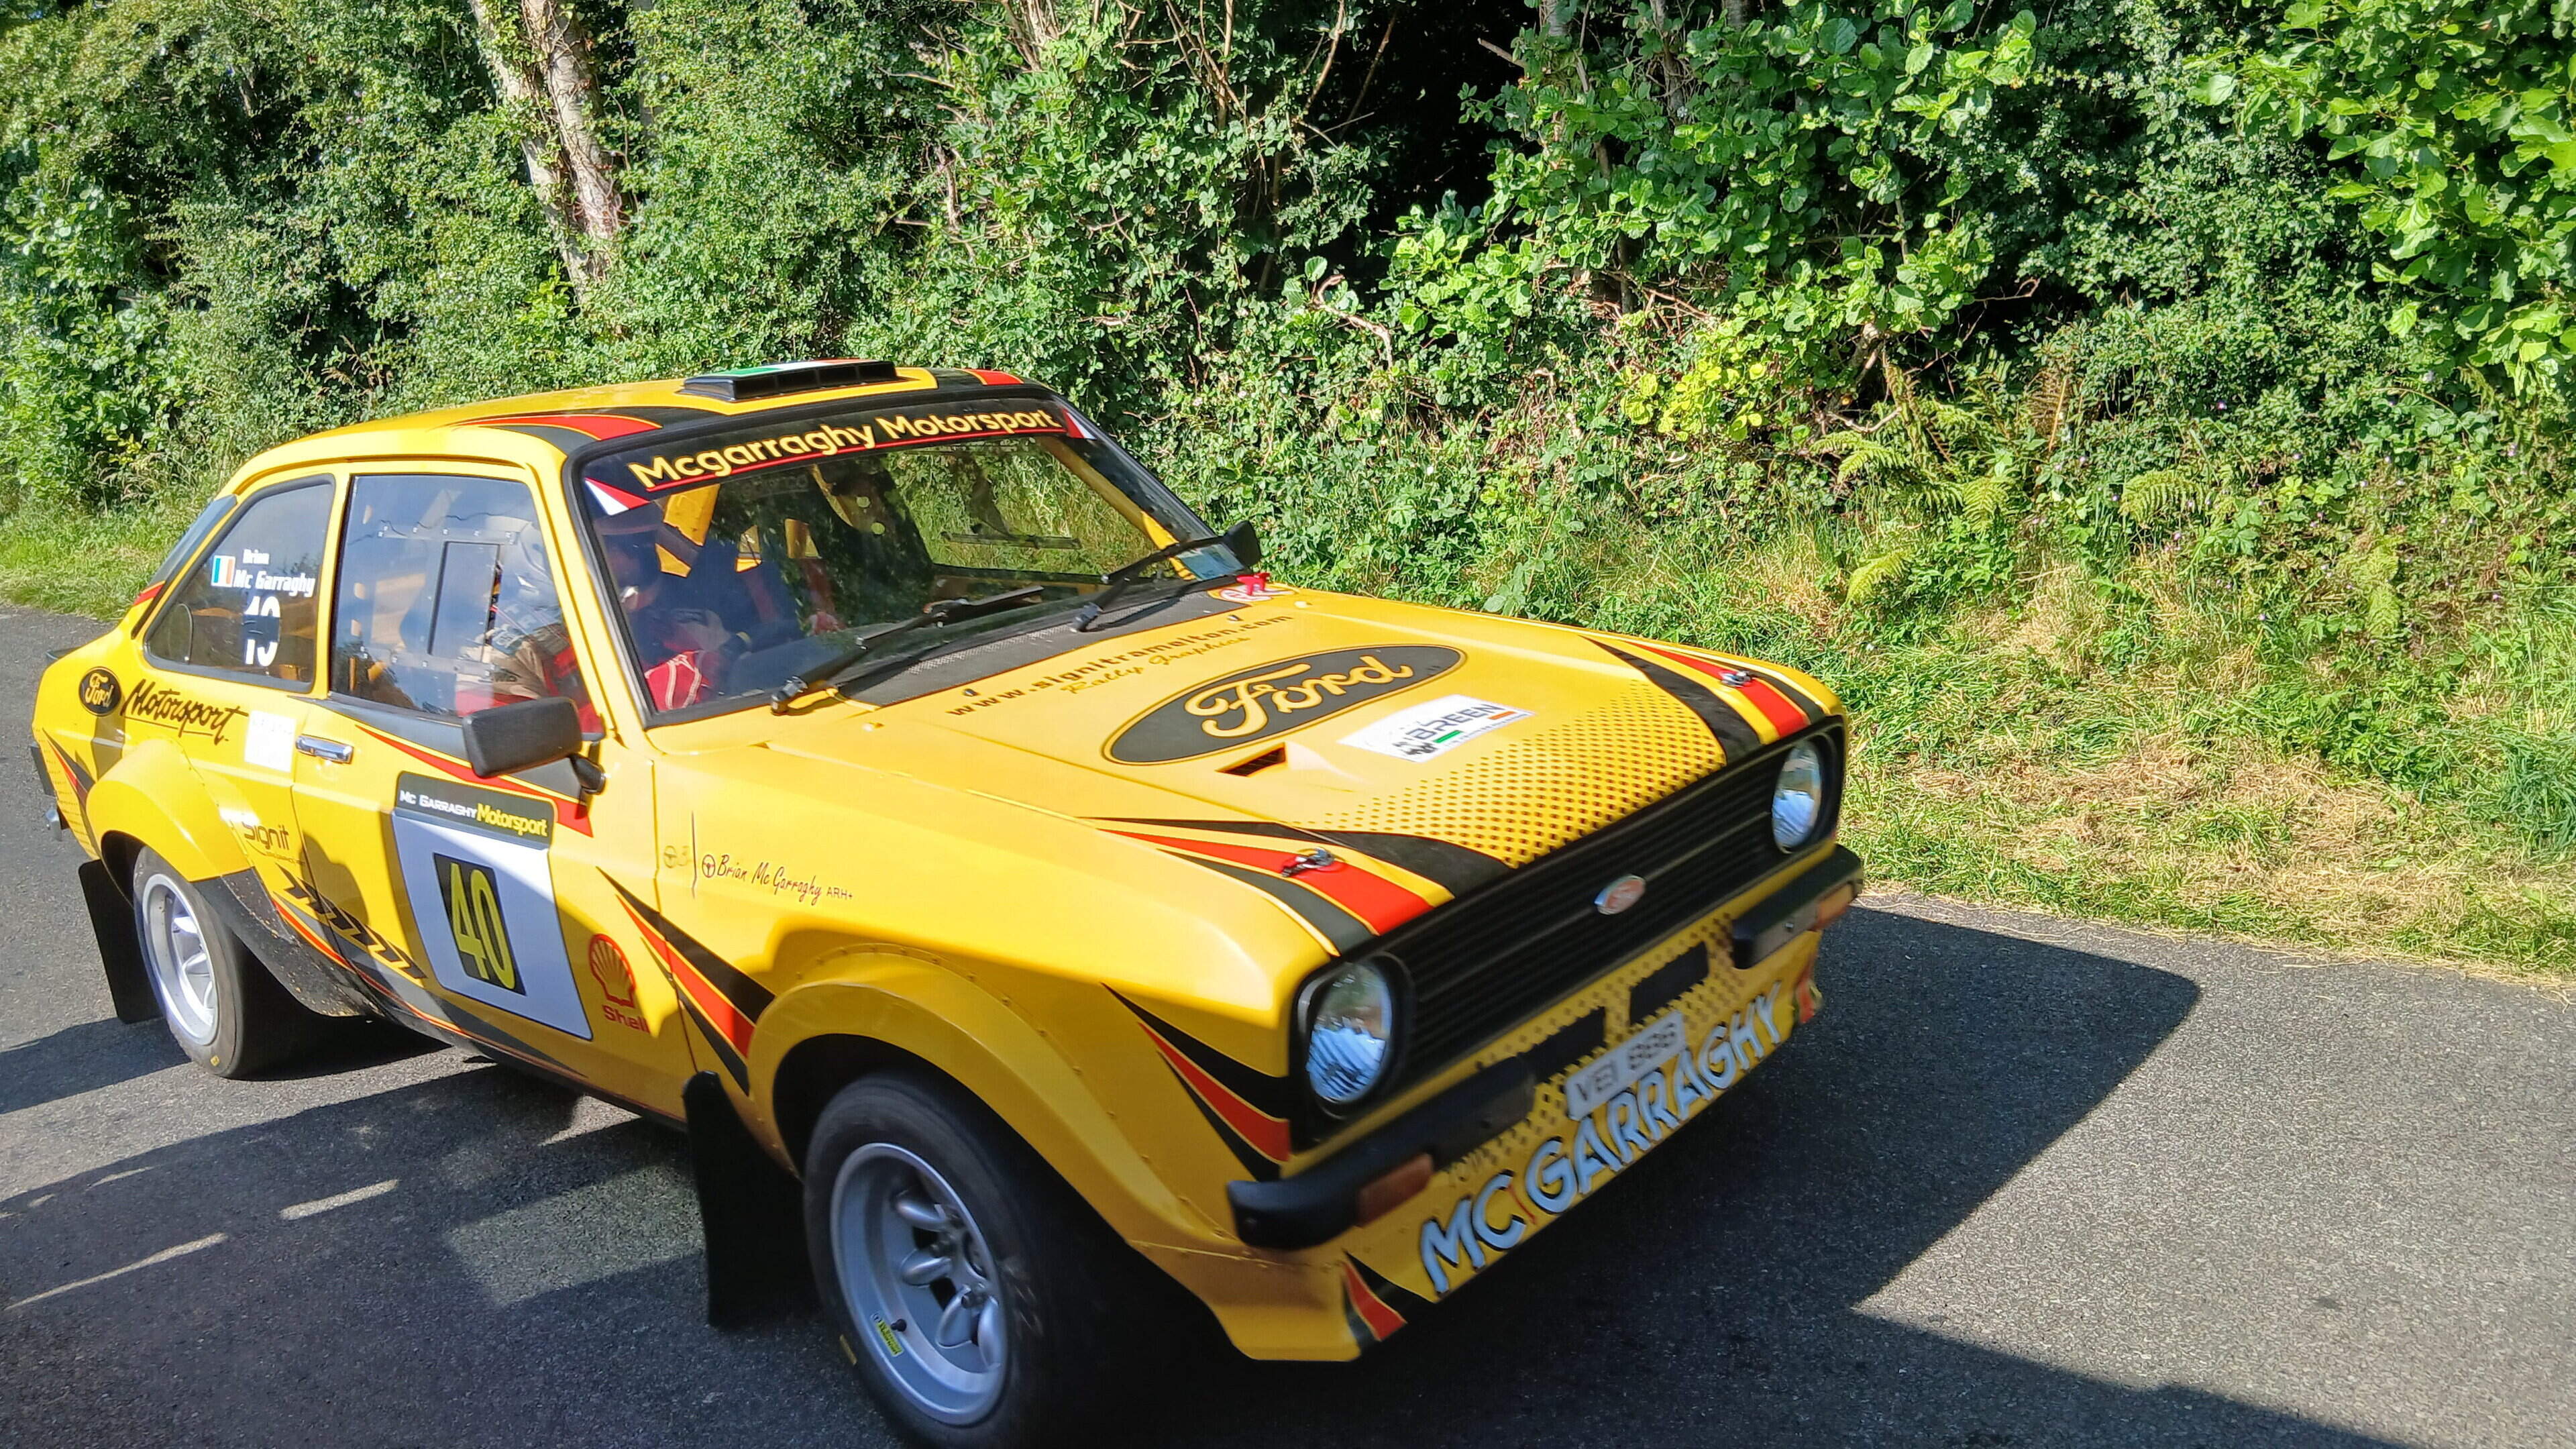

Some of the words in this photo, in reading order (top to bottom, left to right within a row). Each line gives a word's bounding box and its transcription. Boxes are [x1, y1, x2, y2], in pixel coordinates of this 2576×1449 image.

[627, 422, 875, 490] Mcgarraghy
[875, 408, 1061, 442] Motorsport
[233, 569, 254, 589] Mc
[255, 570, 316, 598] Garraghy
[85, 672, 115, 708] Ford
[1184, 655, 1414, 738] Ford
[476, 802, 548, 837] Motorsport
[716, 854, 748, 881] Brian
[751, 861, 770, 885] Mc
[772, 866, 822, 906] Garraghy
[450, 863, 516, 990] 40
[602, 1004, 651, 1034] Shell
[1419, 1169, 1527, 1297] MC
[1524, 979, 1784, 1219] GARRAGHY
